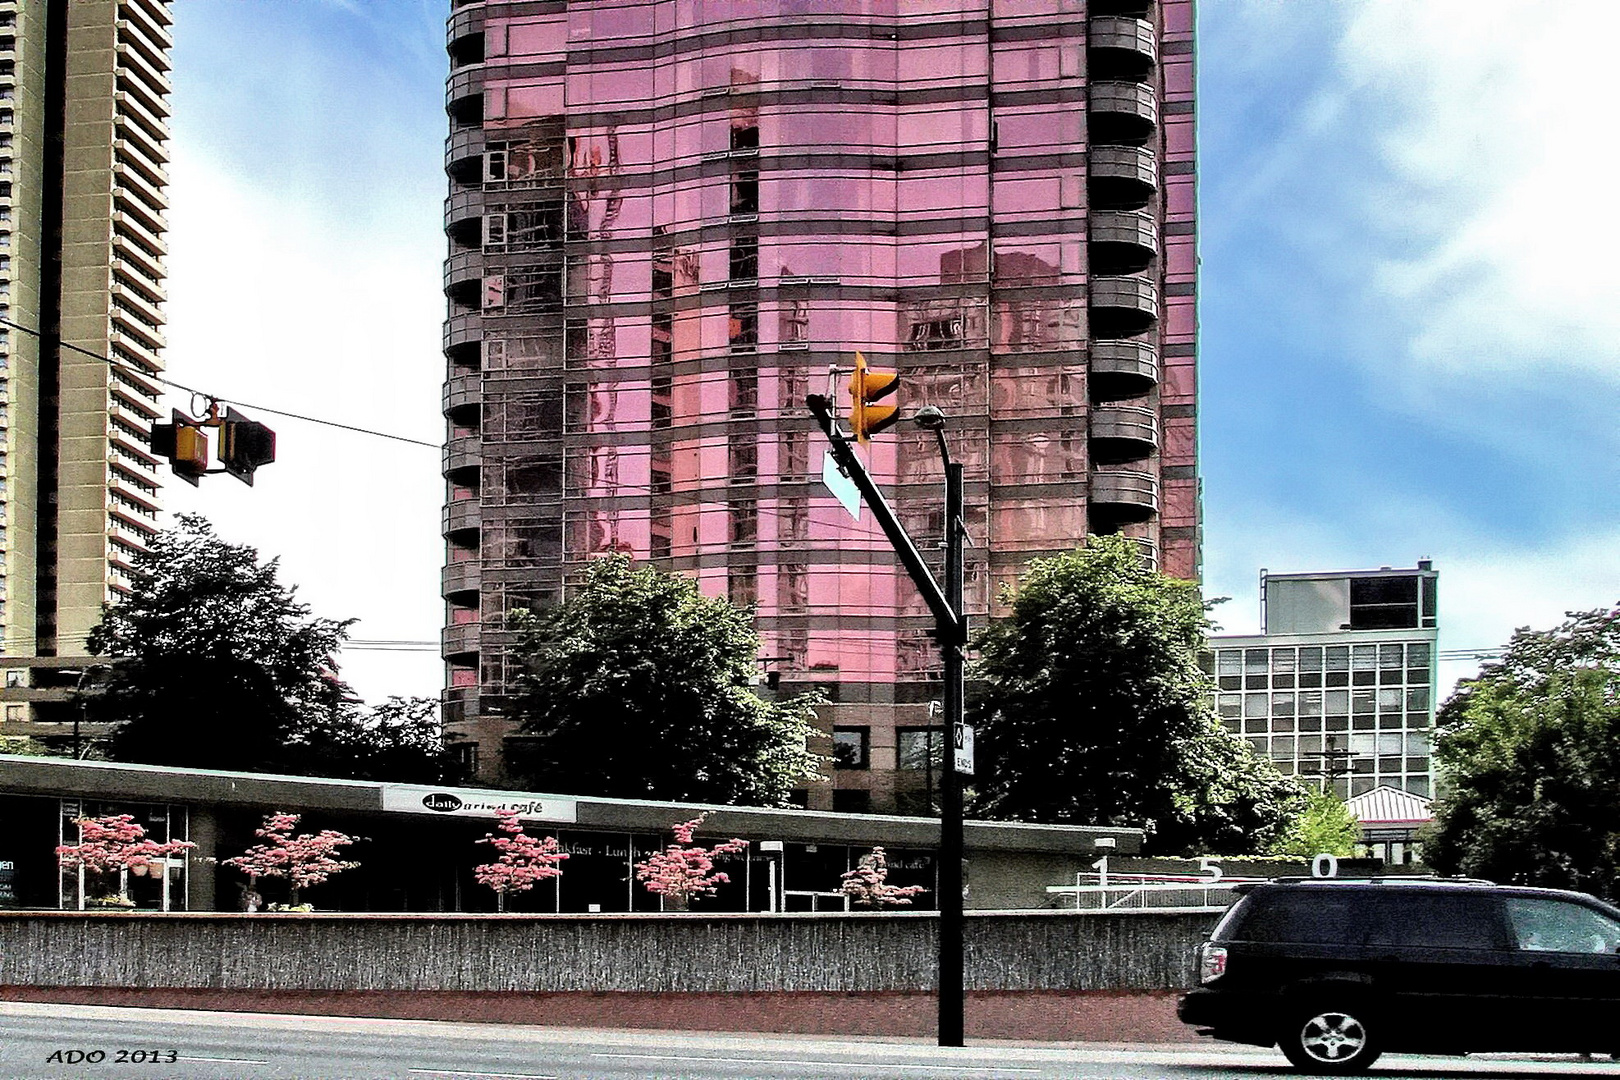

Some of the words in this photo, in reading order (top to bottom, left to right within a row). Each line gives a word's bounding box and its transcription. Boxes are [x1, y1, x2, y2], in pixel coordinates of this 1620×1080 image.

[425, 794, 461, 810] daily
[510, 801, 543, 815] café
[604, 844, 641, 858] Lunh
